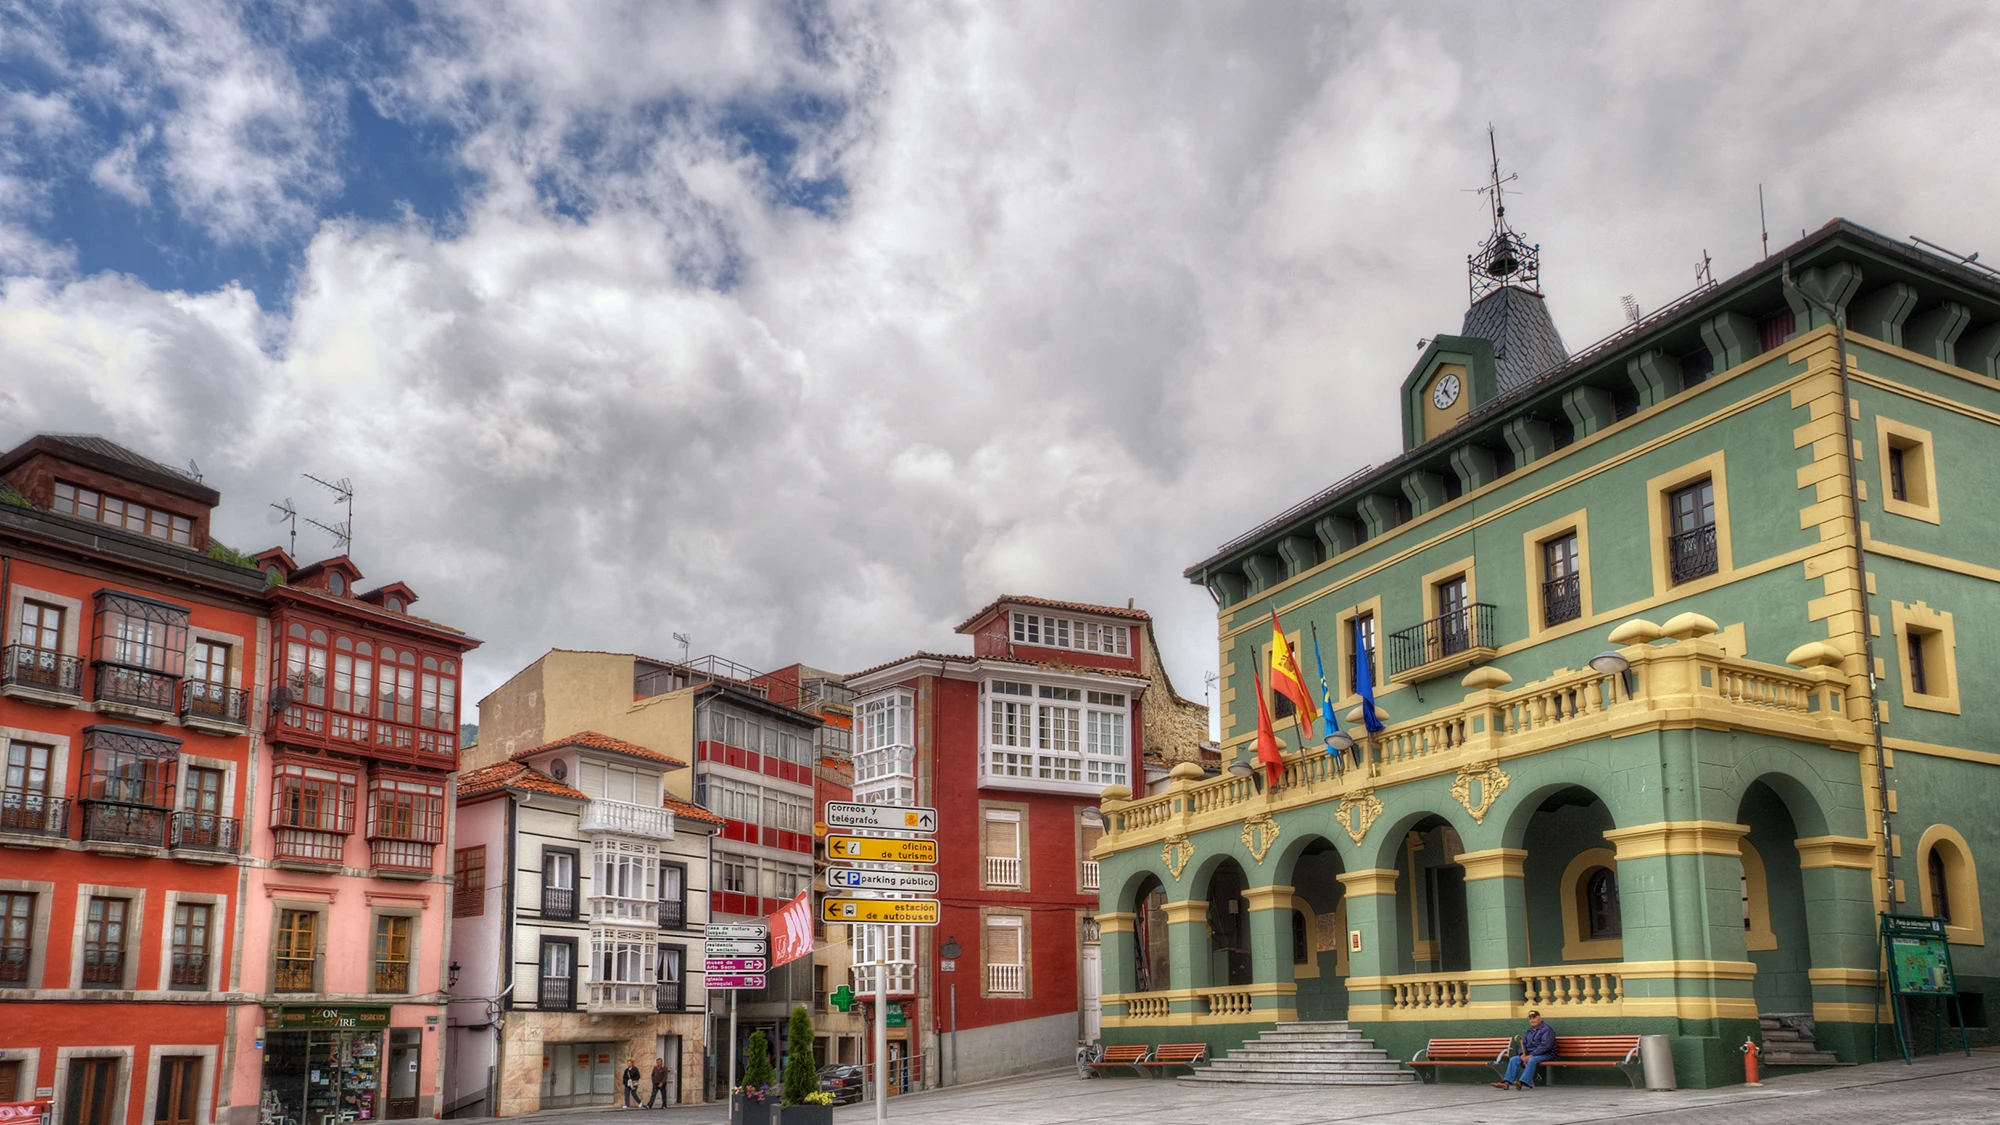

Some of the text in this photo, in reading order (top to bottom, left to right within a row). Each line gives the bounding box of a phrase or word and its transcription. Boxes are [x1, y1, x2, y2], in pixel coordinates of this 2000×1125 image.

[831, 805, 866, 813] correos
[831, 814, 879, 825] telégrafos
[902, 843, 933, 851] oficina
[881, 851, 933, 861] de turismo
[861, 876, 896, 886] parking
[900, 876, 934, 887] público
[895, 904, 935, 912] estación
[884, 913, 935, 921] autobuses
[311, 1008, 339, 1018] DON
